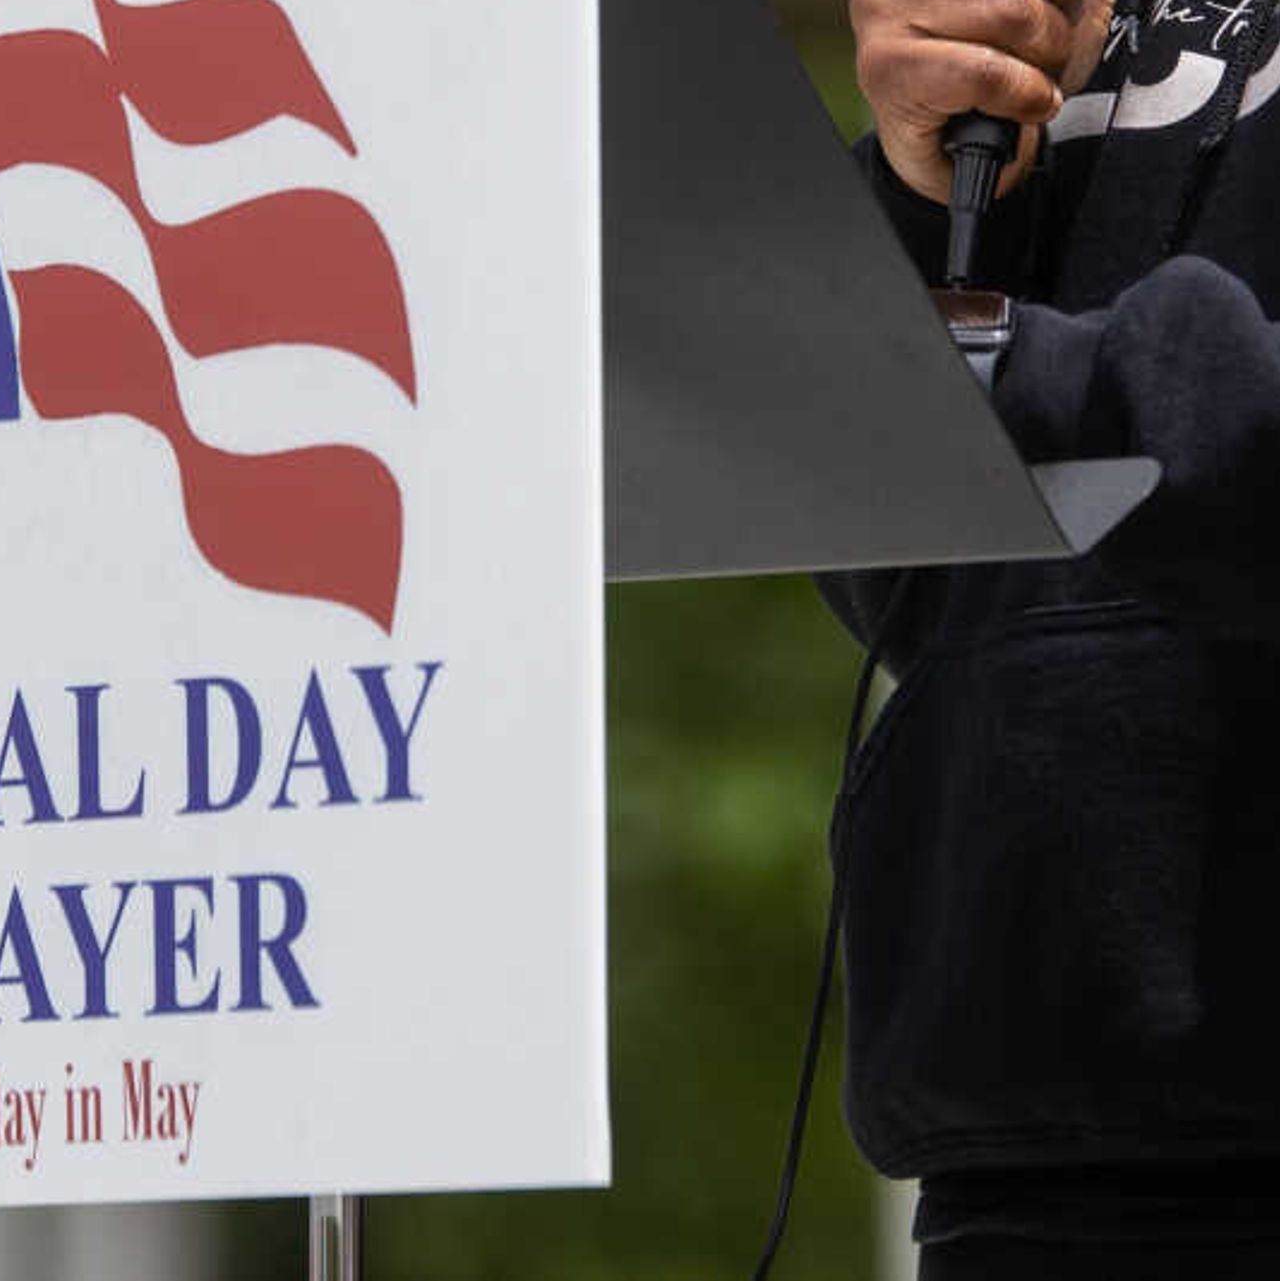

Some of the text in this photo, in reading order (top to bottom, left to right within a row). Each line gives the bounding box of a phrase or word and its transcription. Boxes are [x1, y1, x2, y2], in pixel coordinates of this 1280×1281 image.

[175, 661, 443, 817] DAY
[63, 1062, 103, 1145] in
[122, 1057, 201, 1165] May
